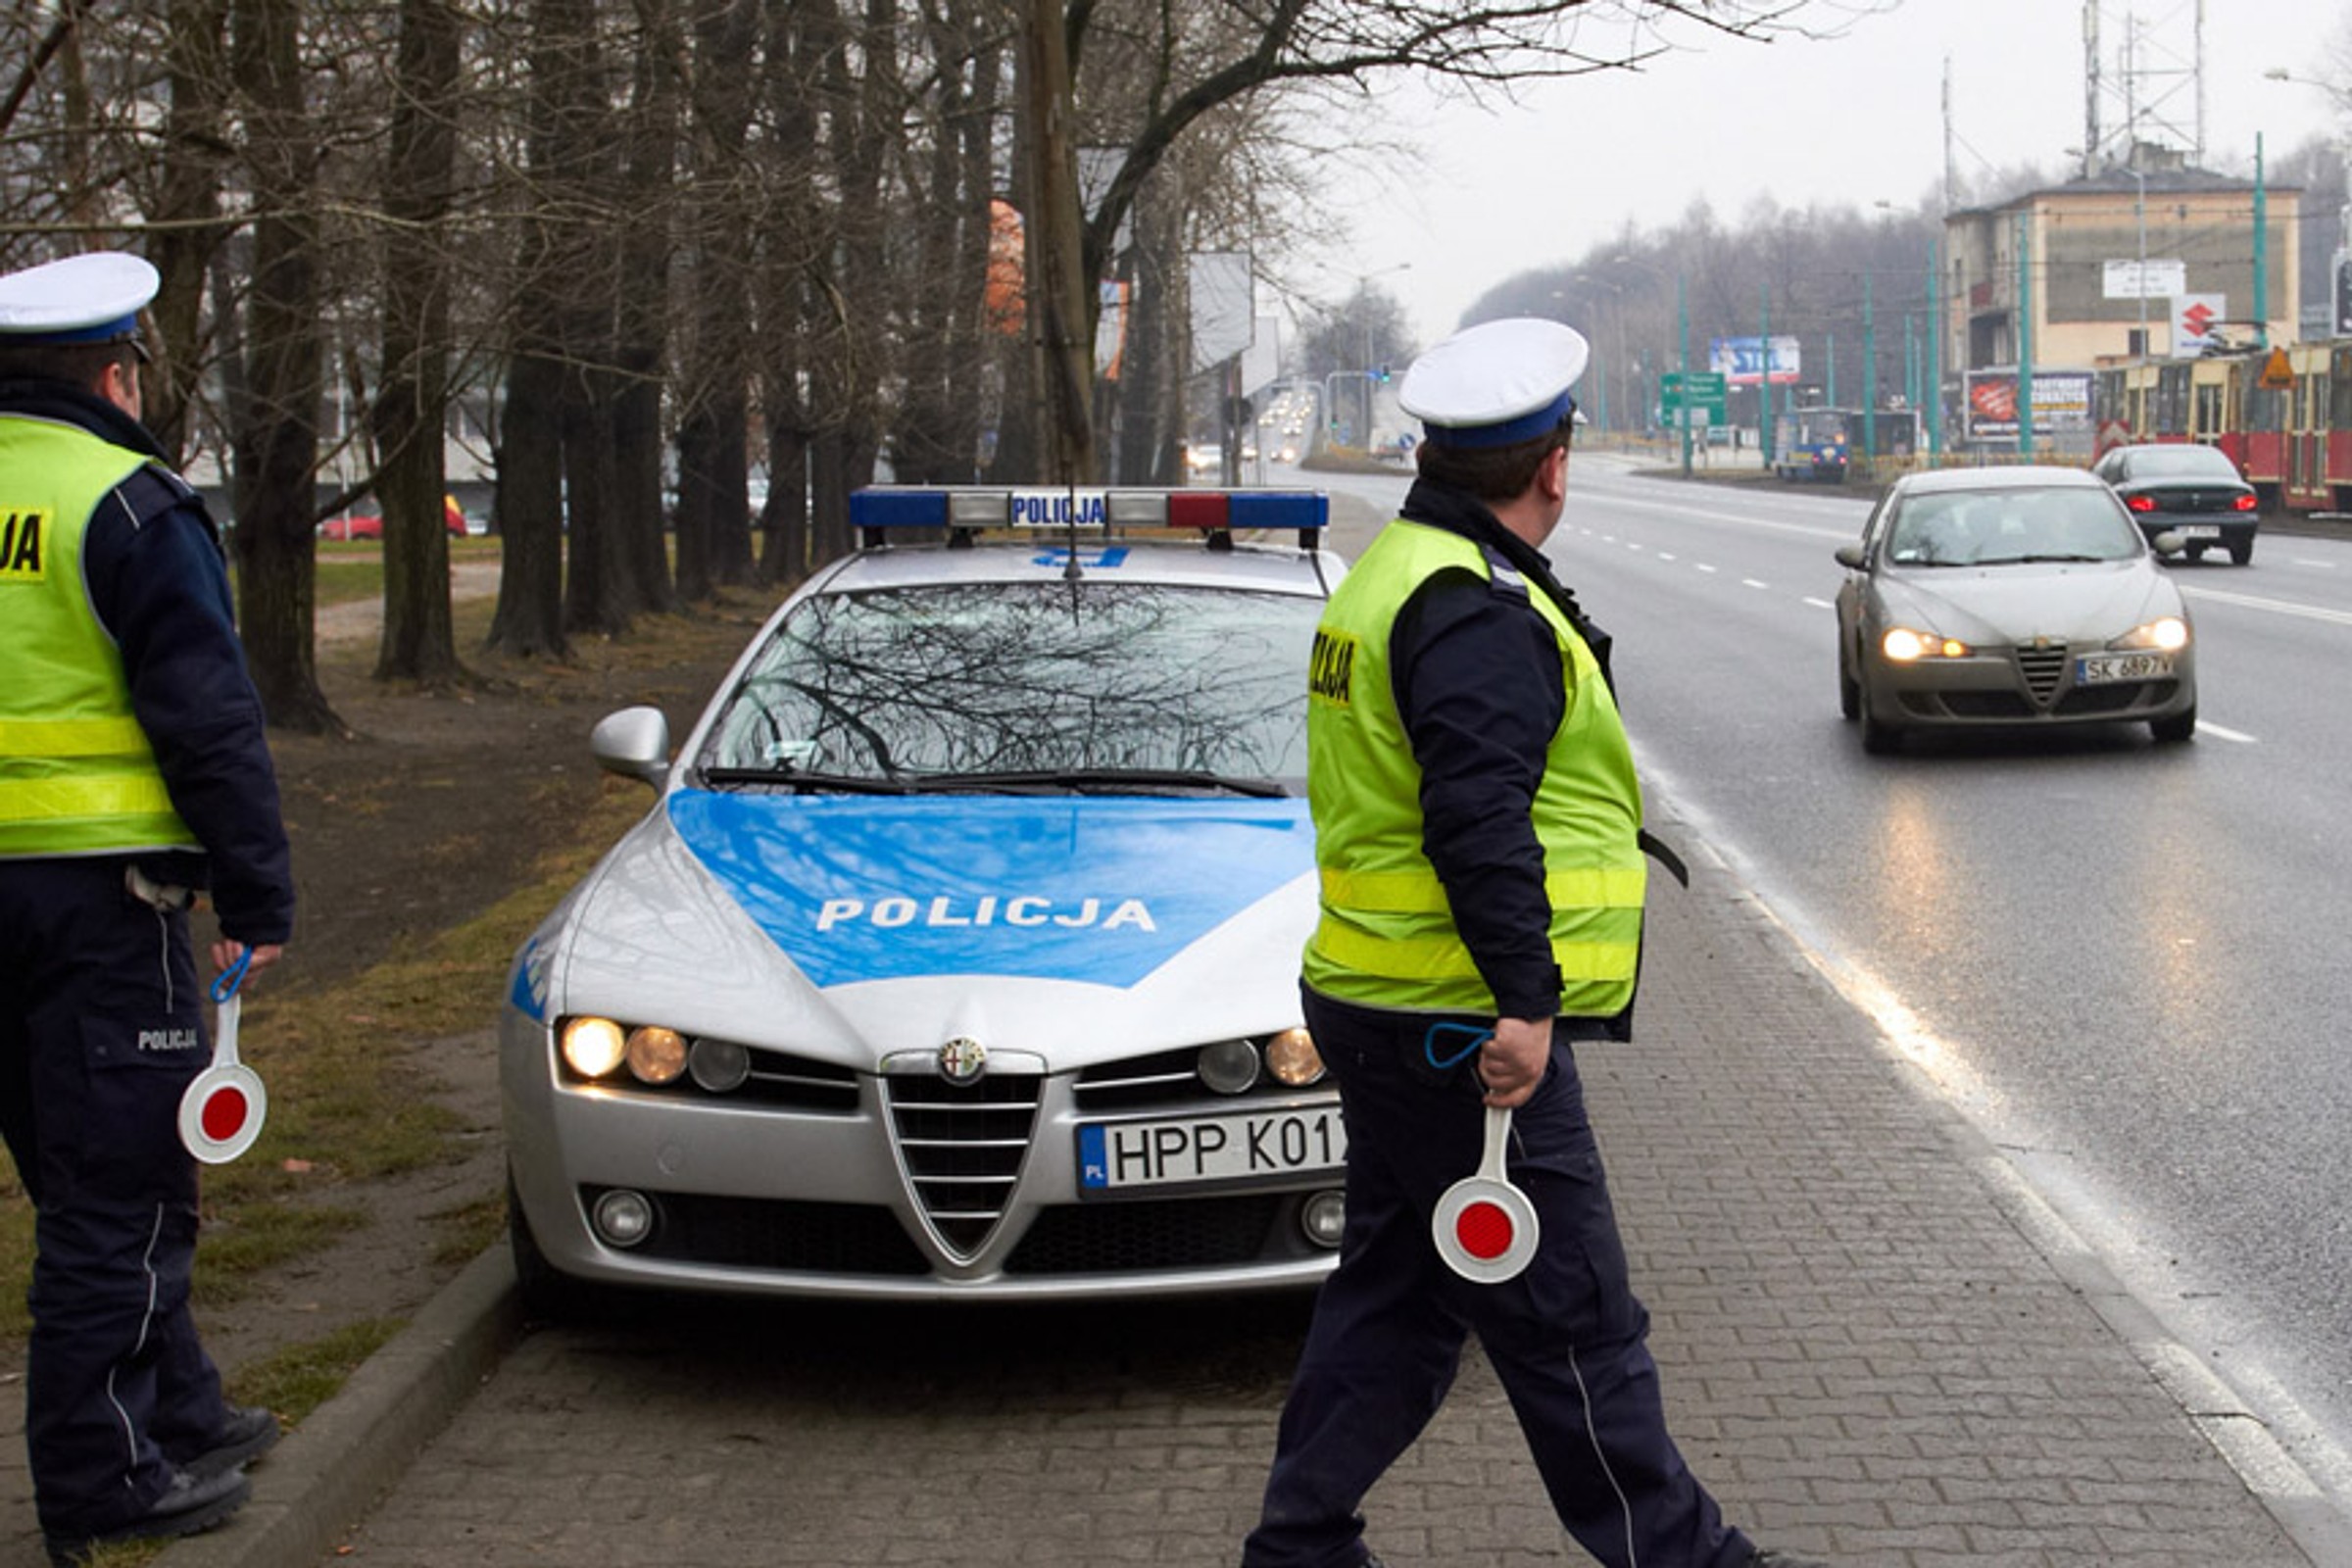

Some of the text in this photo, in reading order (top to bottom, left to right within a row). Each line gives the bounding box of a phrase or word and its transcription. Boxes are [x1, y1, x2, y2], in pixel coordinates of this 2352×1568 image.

[1012, 497, 1106, 524] POLICJA
[2087, 660, 2114, 679] SK
[816, 896, 1157, 932] POLICJA
[138, 1028, 198, 1051] POLICJA
[1086, 1113, 1347, 1181] PL HPP K01
